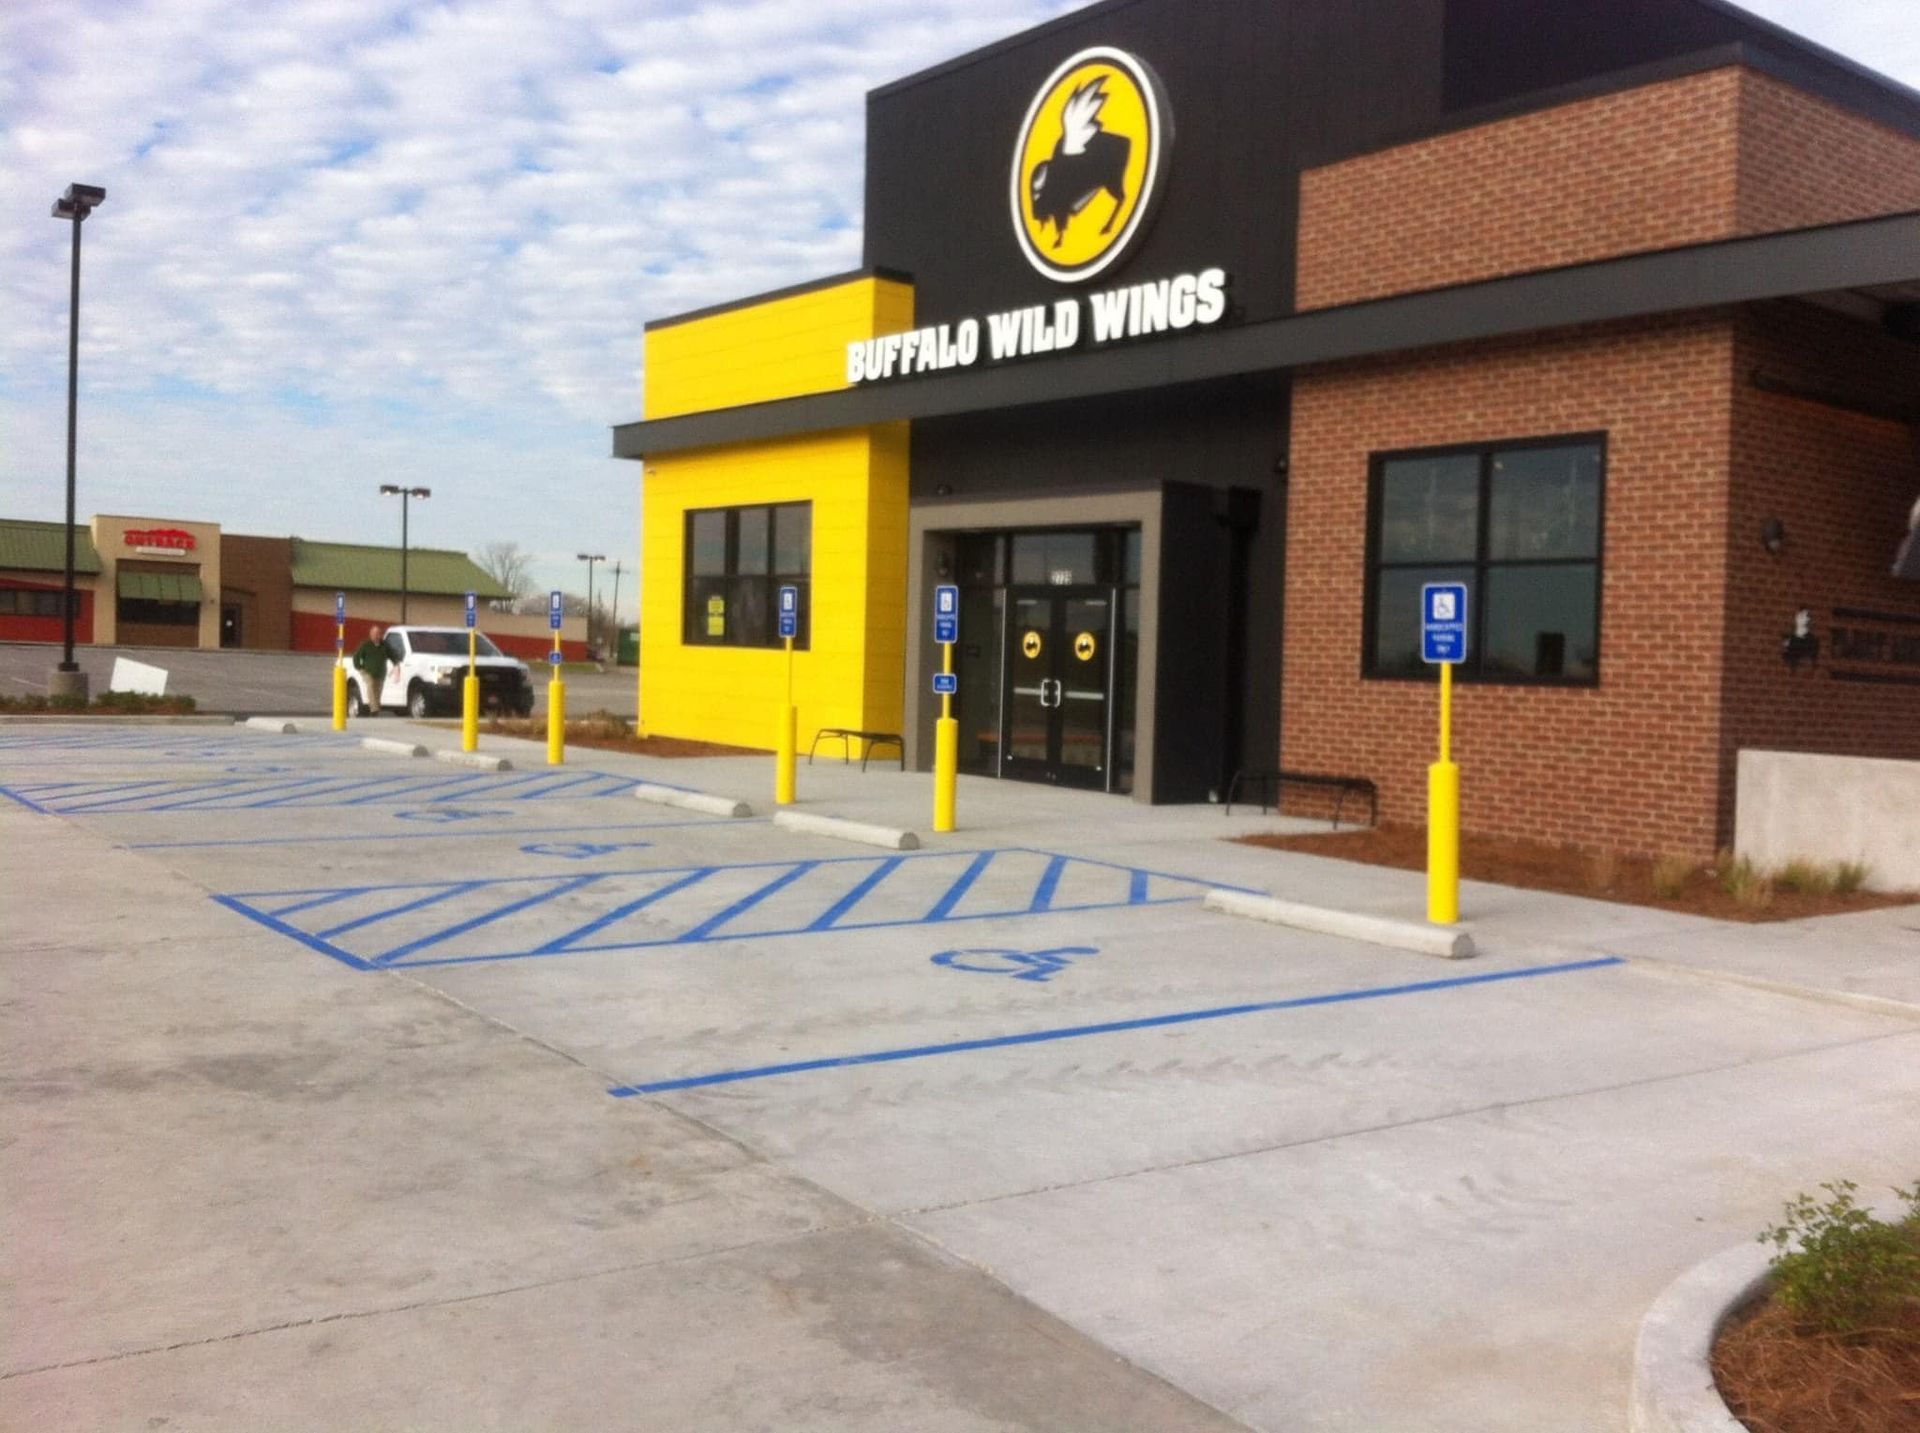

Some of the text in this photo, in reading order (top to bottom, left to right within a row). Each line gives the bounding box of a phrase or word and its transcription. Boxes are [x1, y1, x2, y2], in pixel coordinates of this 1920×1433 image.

[847, 268, 1226, 384] BUFFALO WILD WINGS
